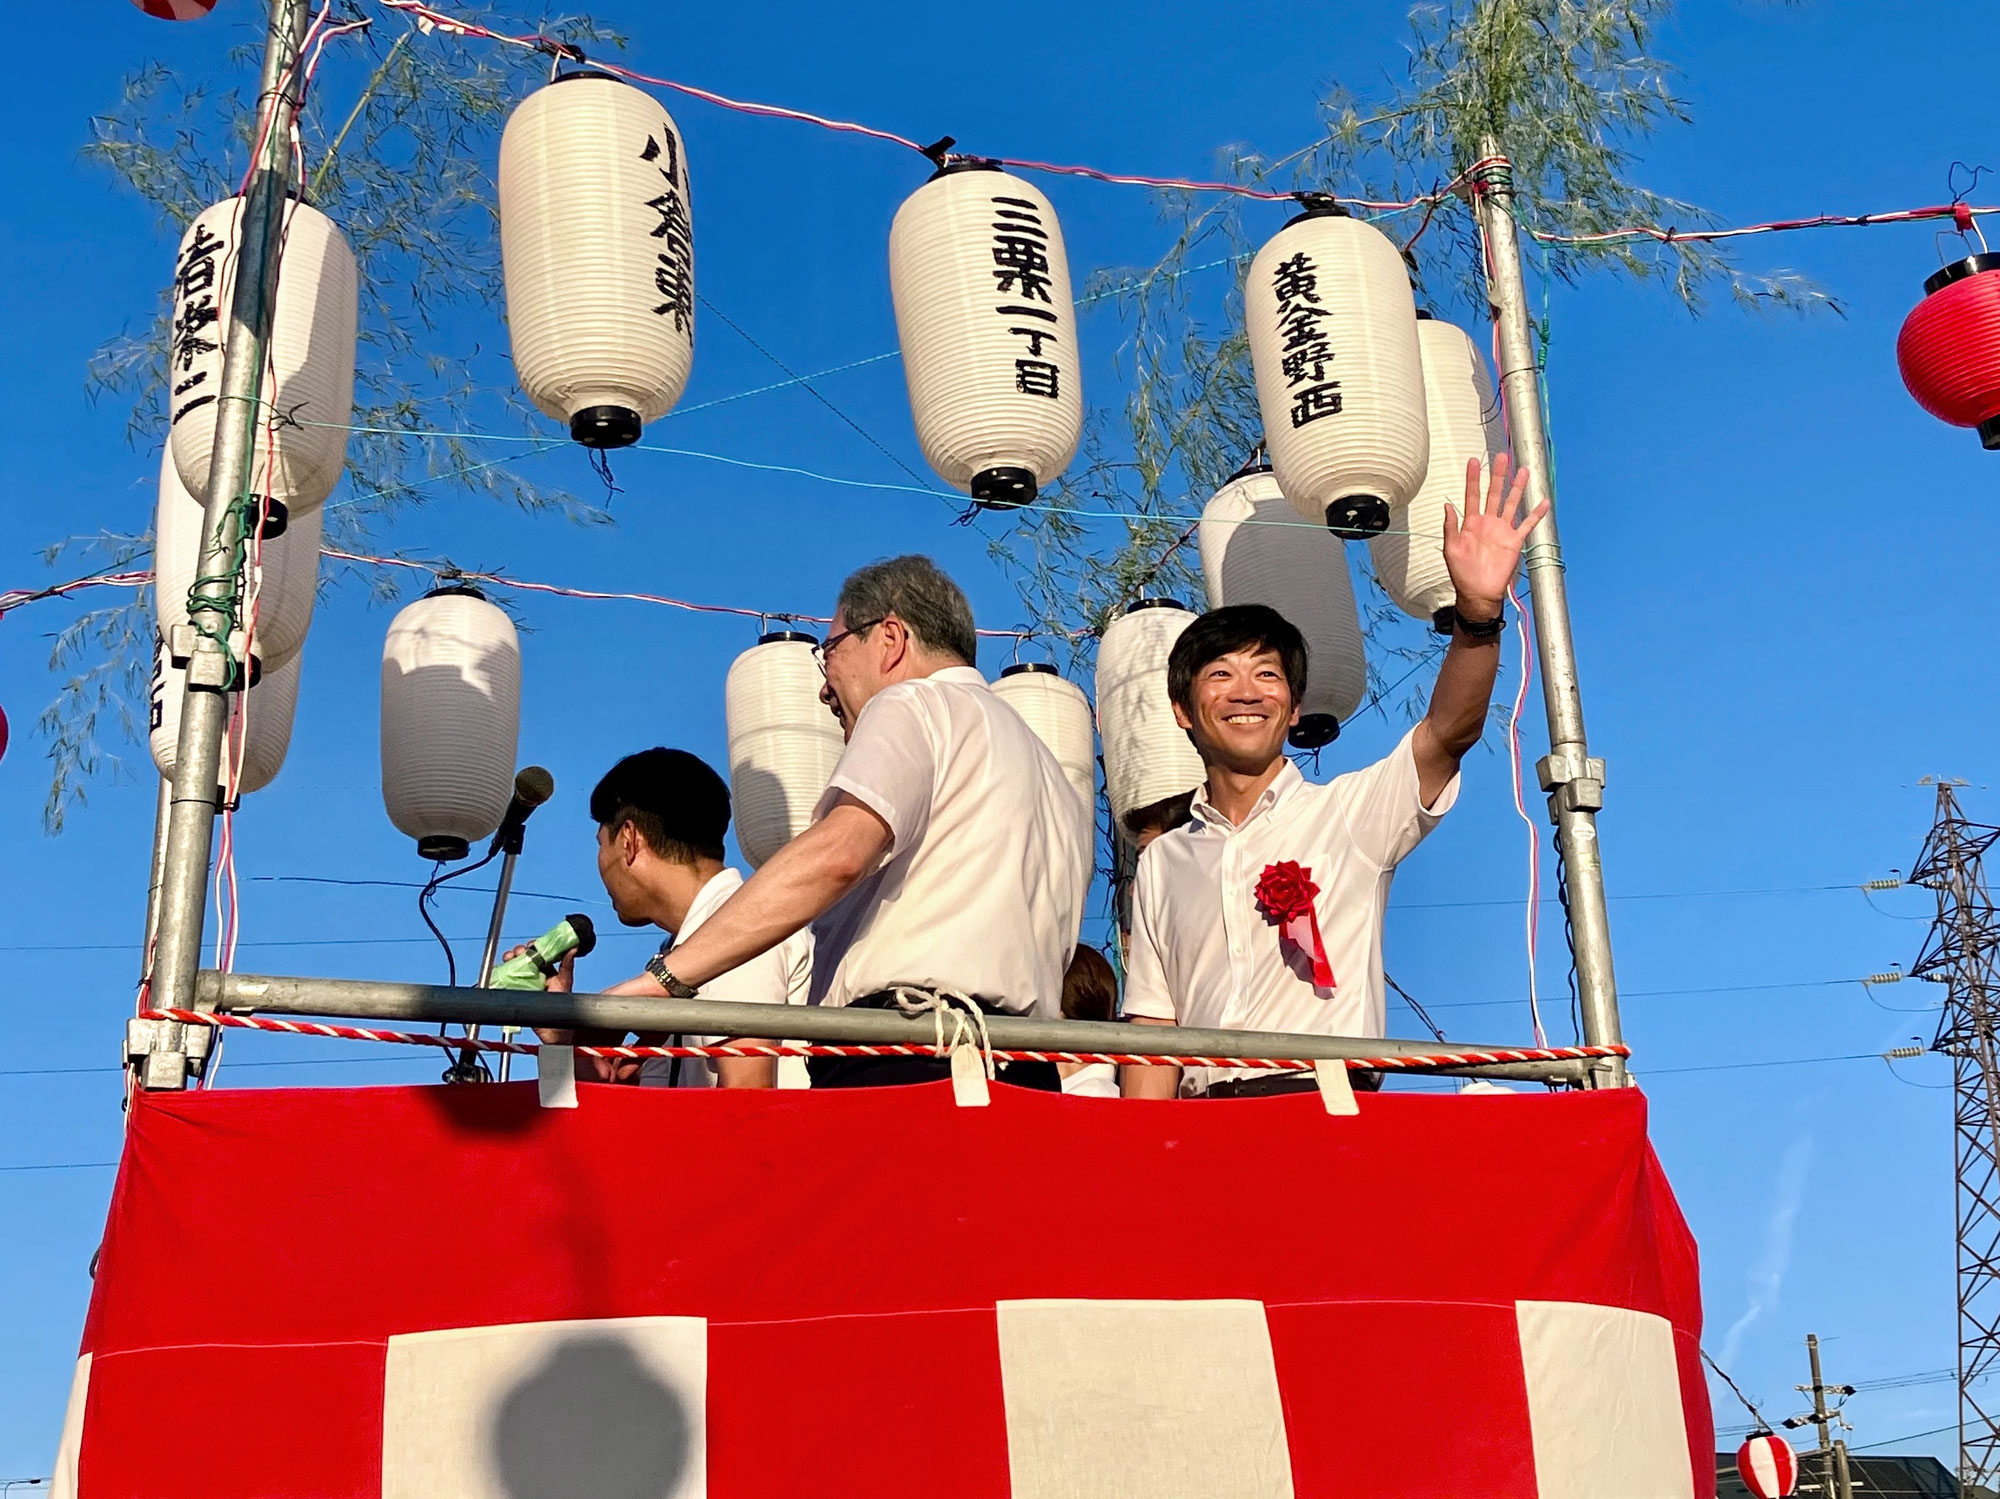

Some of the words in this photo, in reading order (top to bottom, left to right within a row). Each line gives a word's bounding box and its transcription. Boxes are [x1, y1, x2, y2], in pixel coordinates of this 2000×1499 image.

[991, 197, 1060, 399] 三栗一丁目
[1272, 252, 1343, 429] 黄金野西
